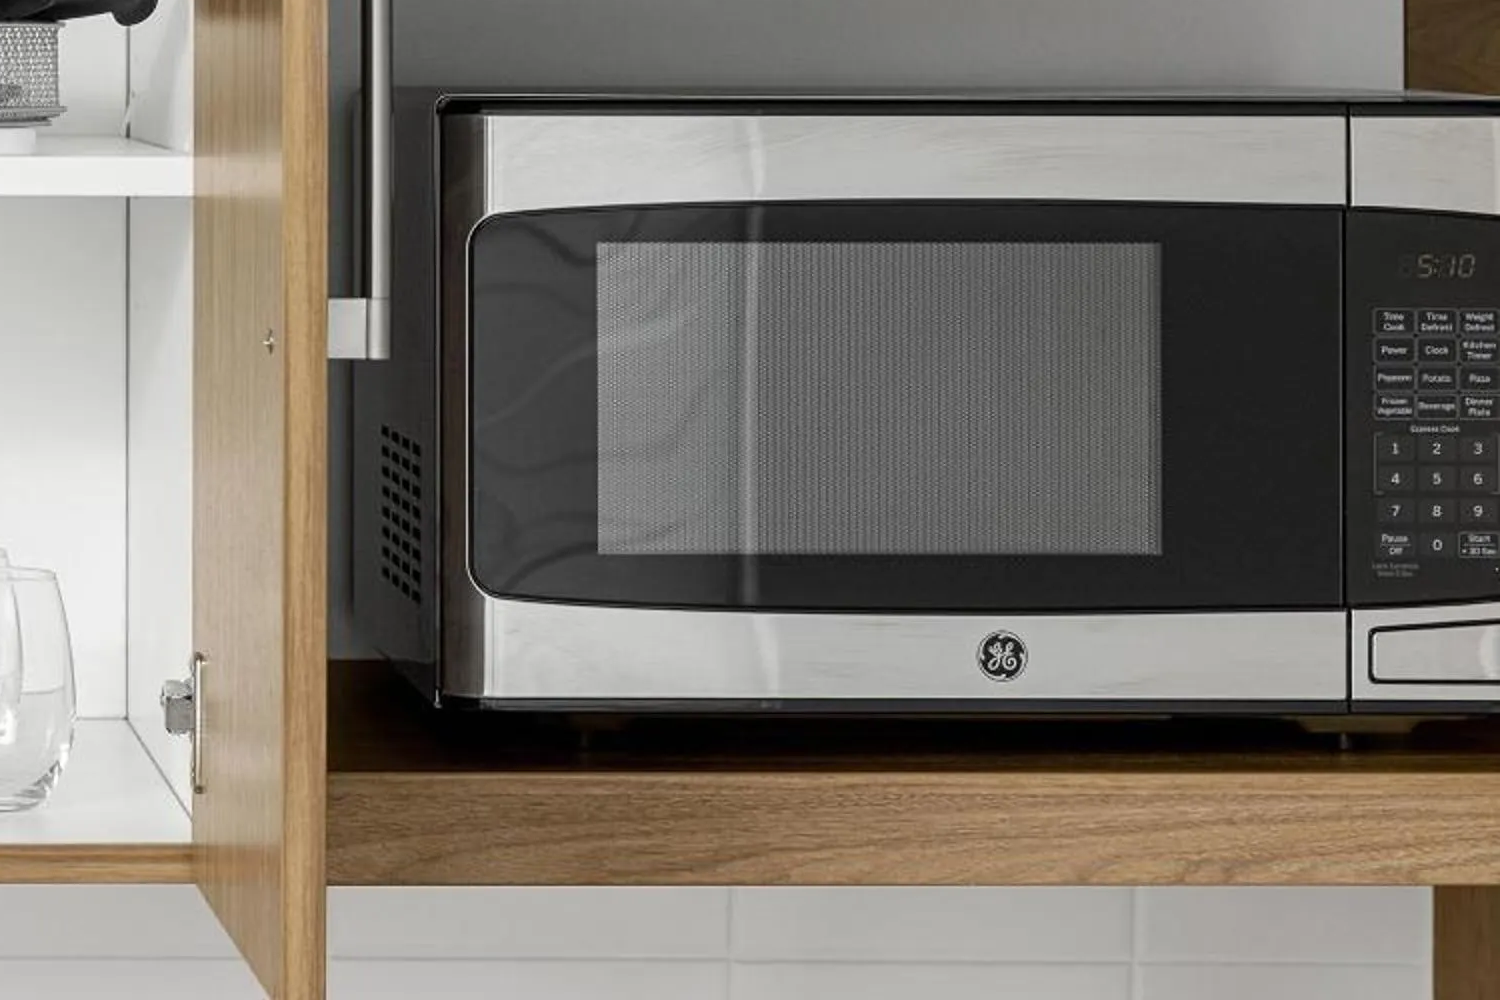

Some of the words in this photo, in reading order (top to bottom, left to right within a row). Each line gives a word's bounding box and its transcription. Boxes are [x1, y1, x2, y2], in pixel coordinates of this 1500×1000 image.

[1417, 254, 1476, 278] 5:10
[1425, 345, 1448, 355] Clock
[1391, 442, 1400, 455] 1
[1432, 442, 1442, 455] 2
[1473, 442, 1483, 455] 3
[1391, 472, 1400, 485] 4
[1432, 472, 1442, 485] 5
[1473, 472, 1483, 485] 6
[1391, 505, 1400, 517] 7
[1432, 505, 1442, 517] 8
[1473, 505, 1483, 517] 9
[1432, 539, 1443, 551] 0
